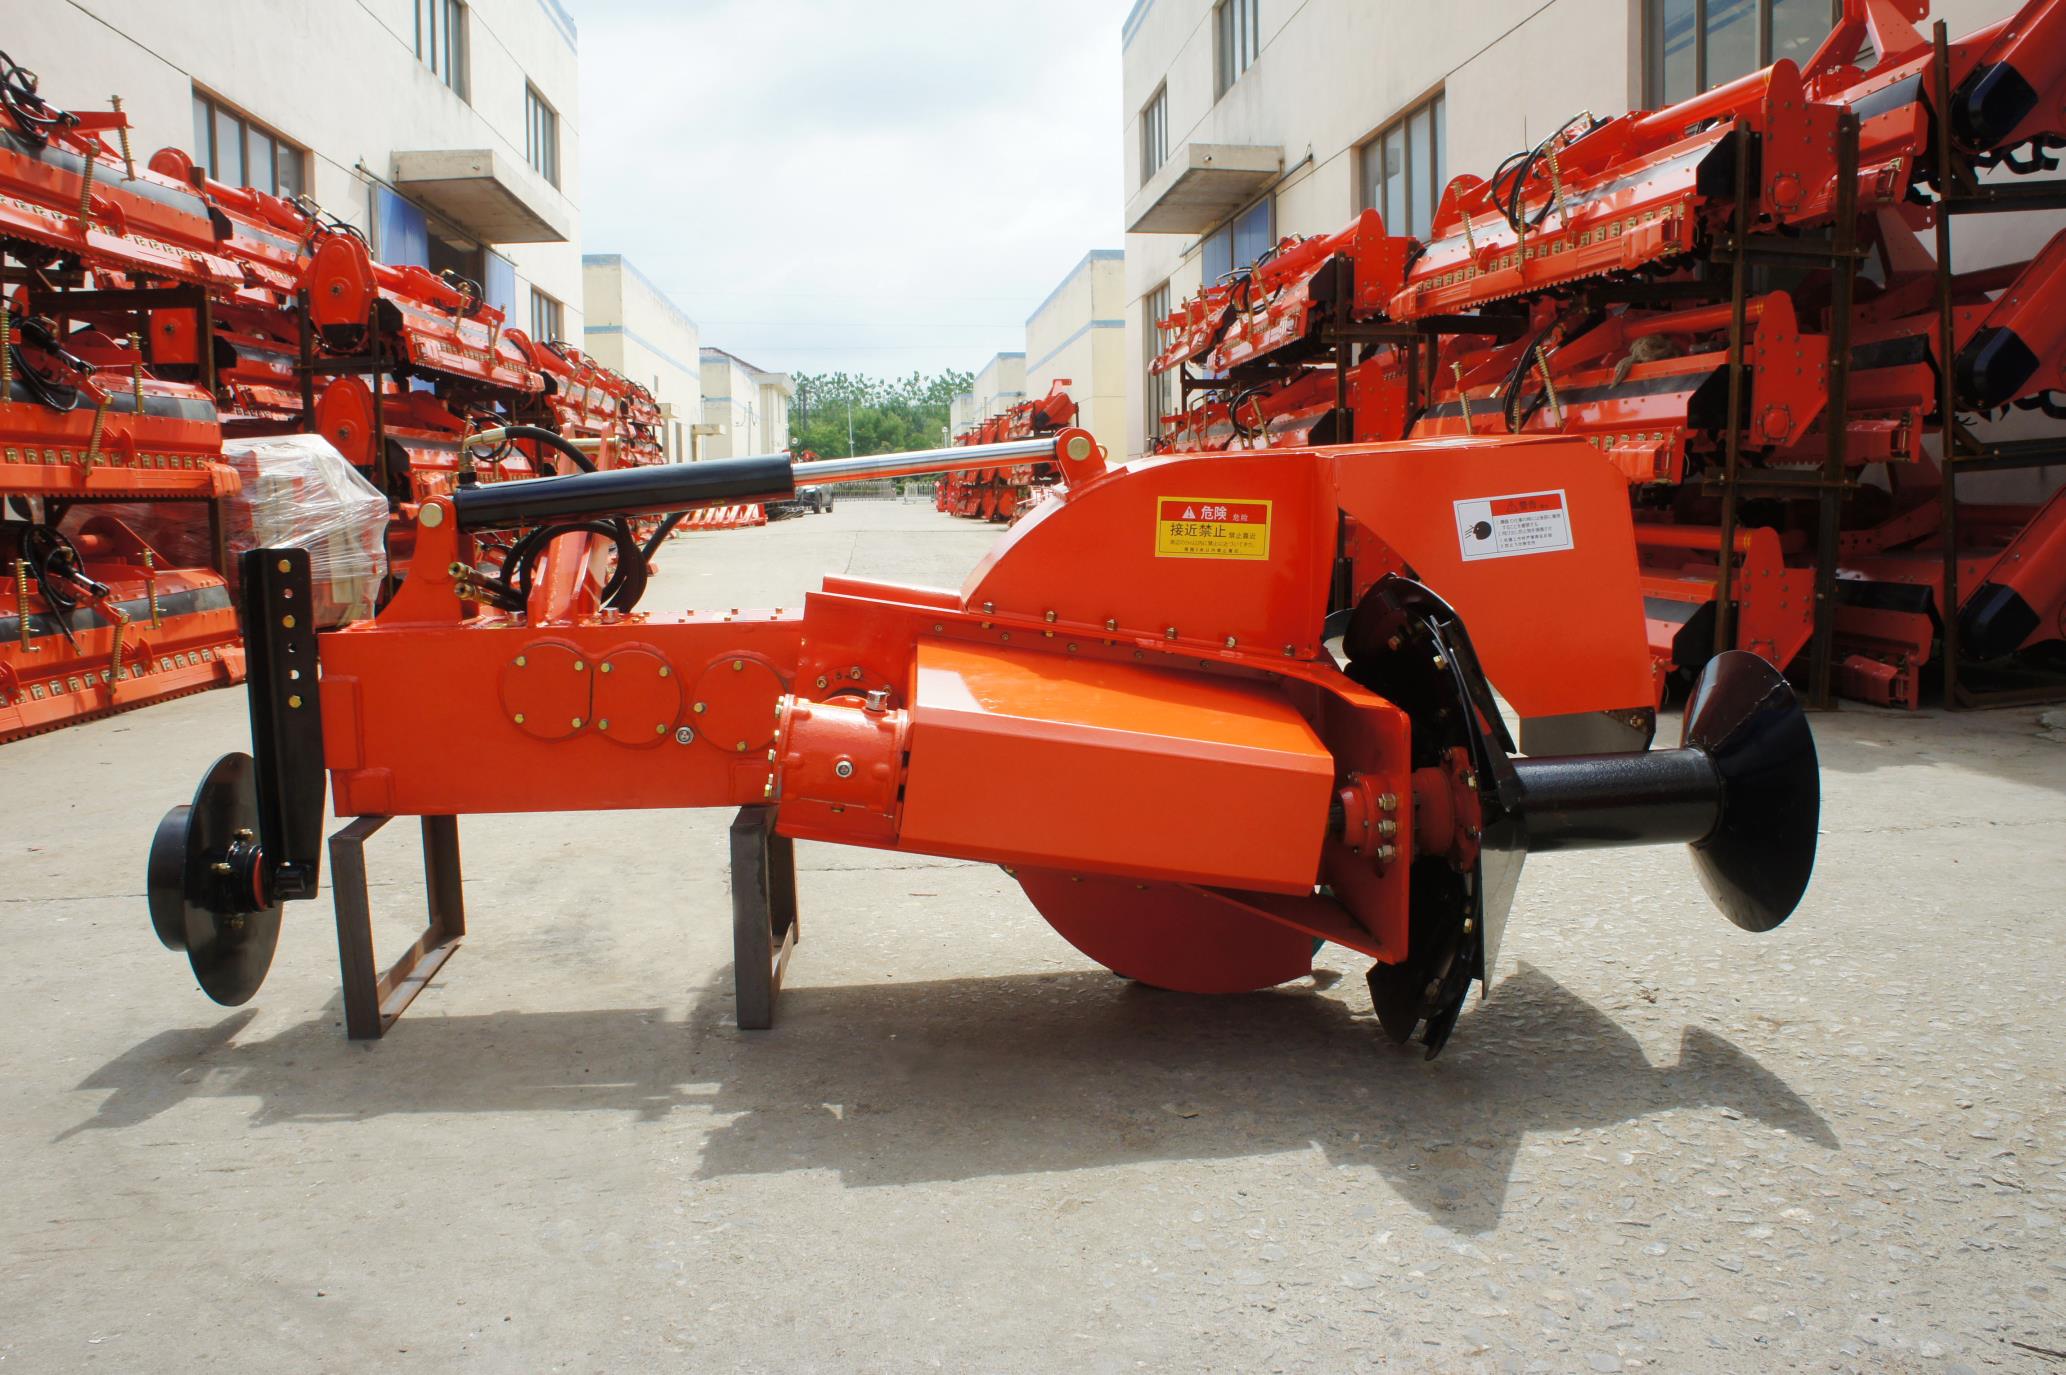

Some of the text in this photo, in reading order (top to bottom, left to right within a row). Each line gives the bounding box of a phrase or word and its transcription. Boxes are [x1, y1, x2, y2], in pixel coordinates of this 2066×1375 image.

[1200, 505, 1227, 520] 危険
[1169, 523, 1226, 538] 接近禁止
